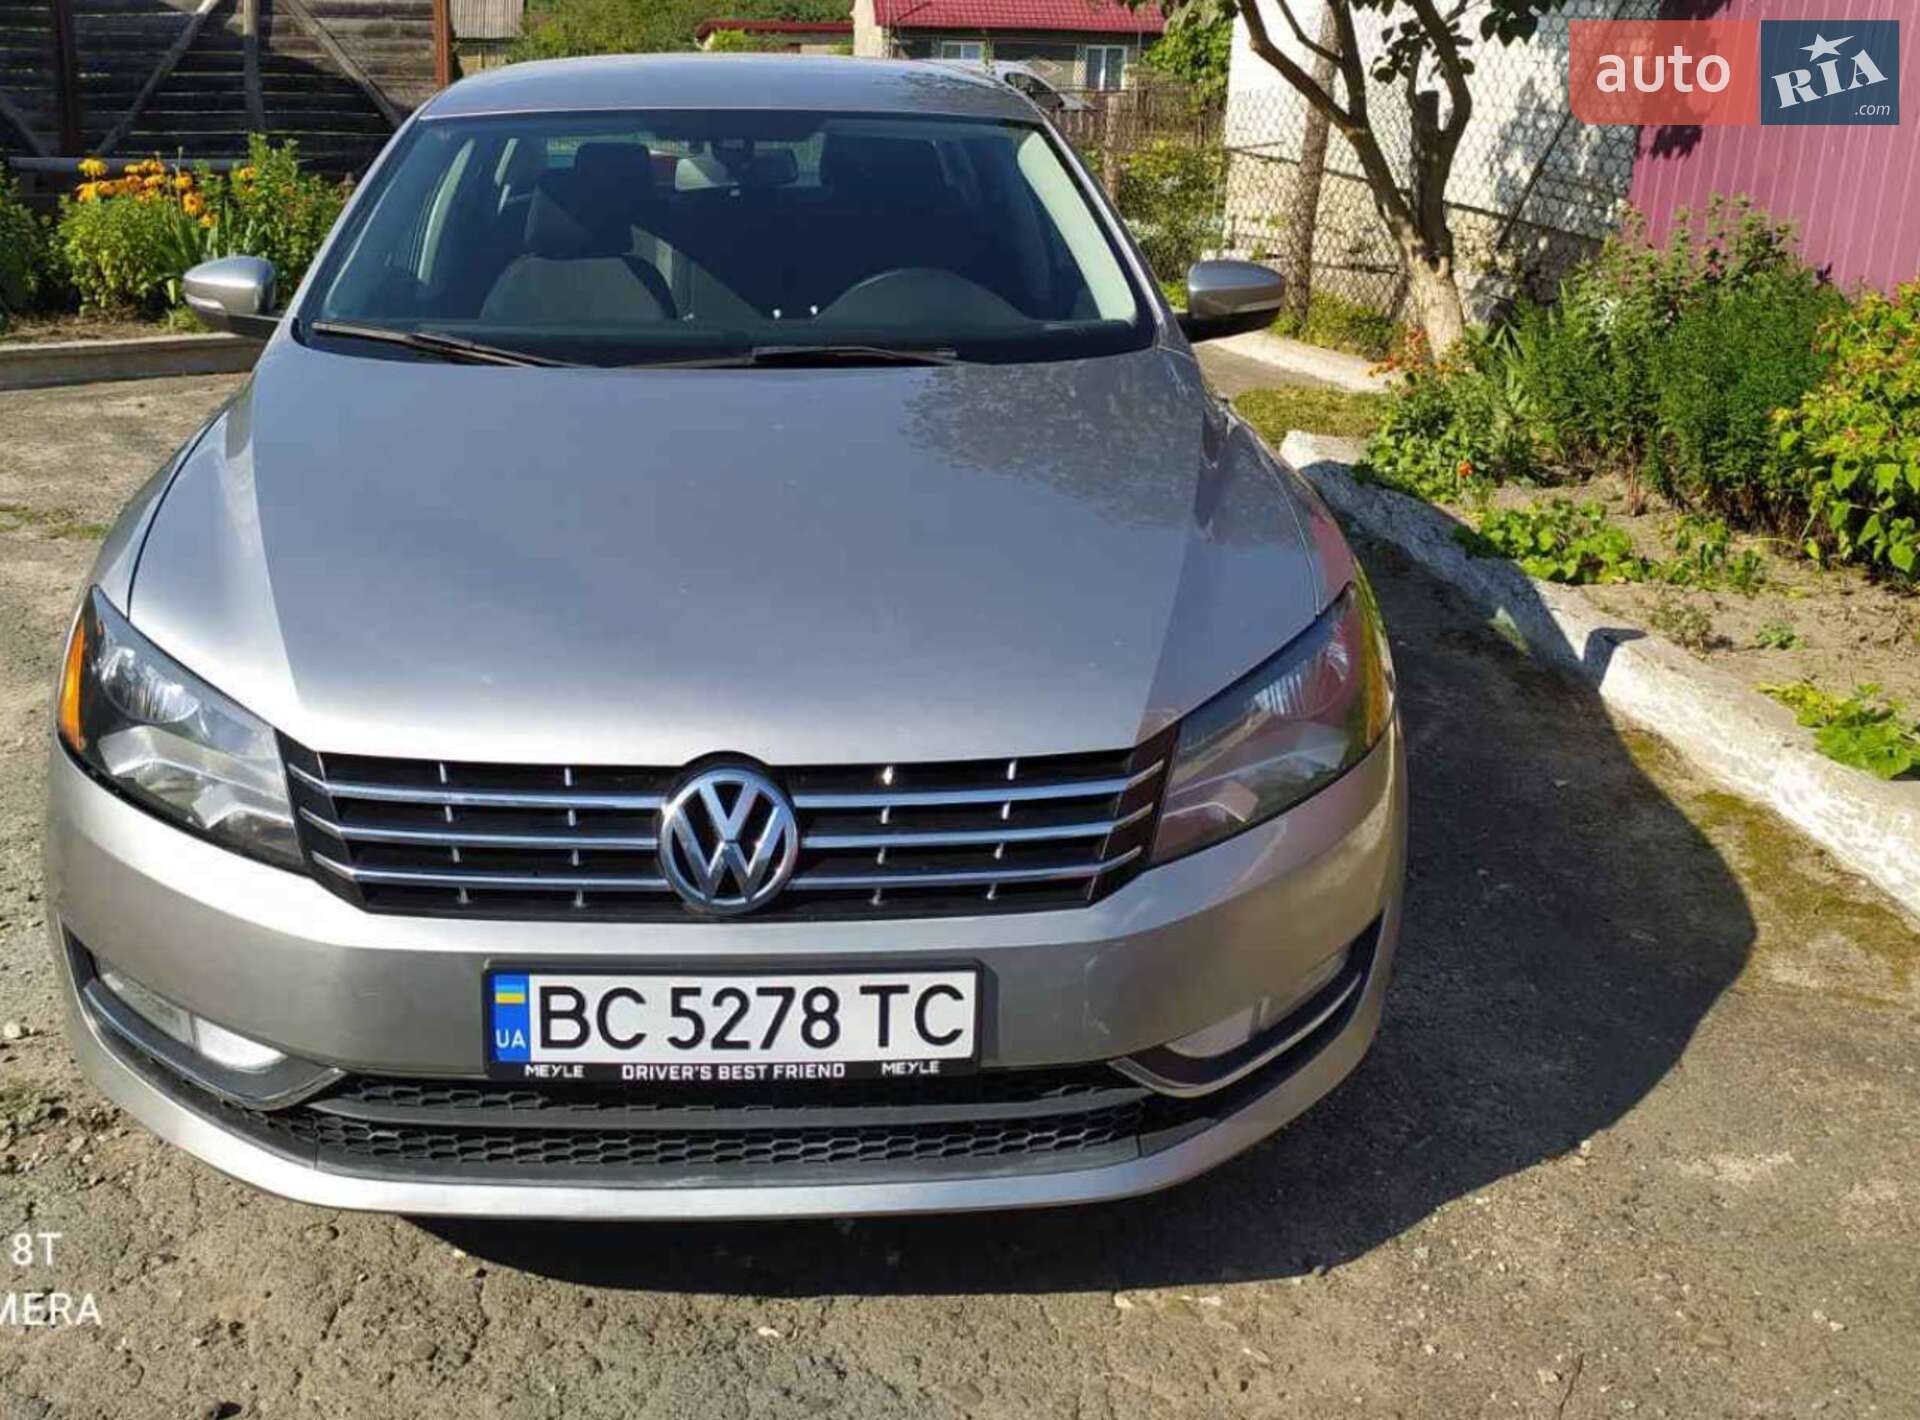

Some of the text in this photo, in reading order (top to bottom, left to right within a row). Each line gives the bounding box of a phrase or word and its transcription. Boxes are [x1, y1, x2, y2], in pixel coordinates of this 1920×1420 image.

[538, 984, 965, 1051] BC 5278 TC
[495, 1030, 526, 1049] UA
[524, 1064, 584, 1078] MEYLE
[622, 1063, 846, 1081] DRIVER'S BEST FRIEND
[882, 1061, 940, 1075] MEYLE
